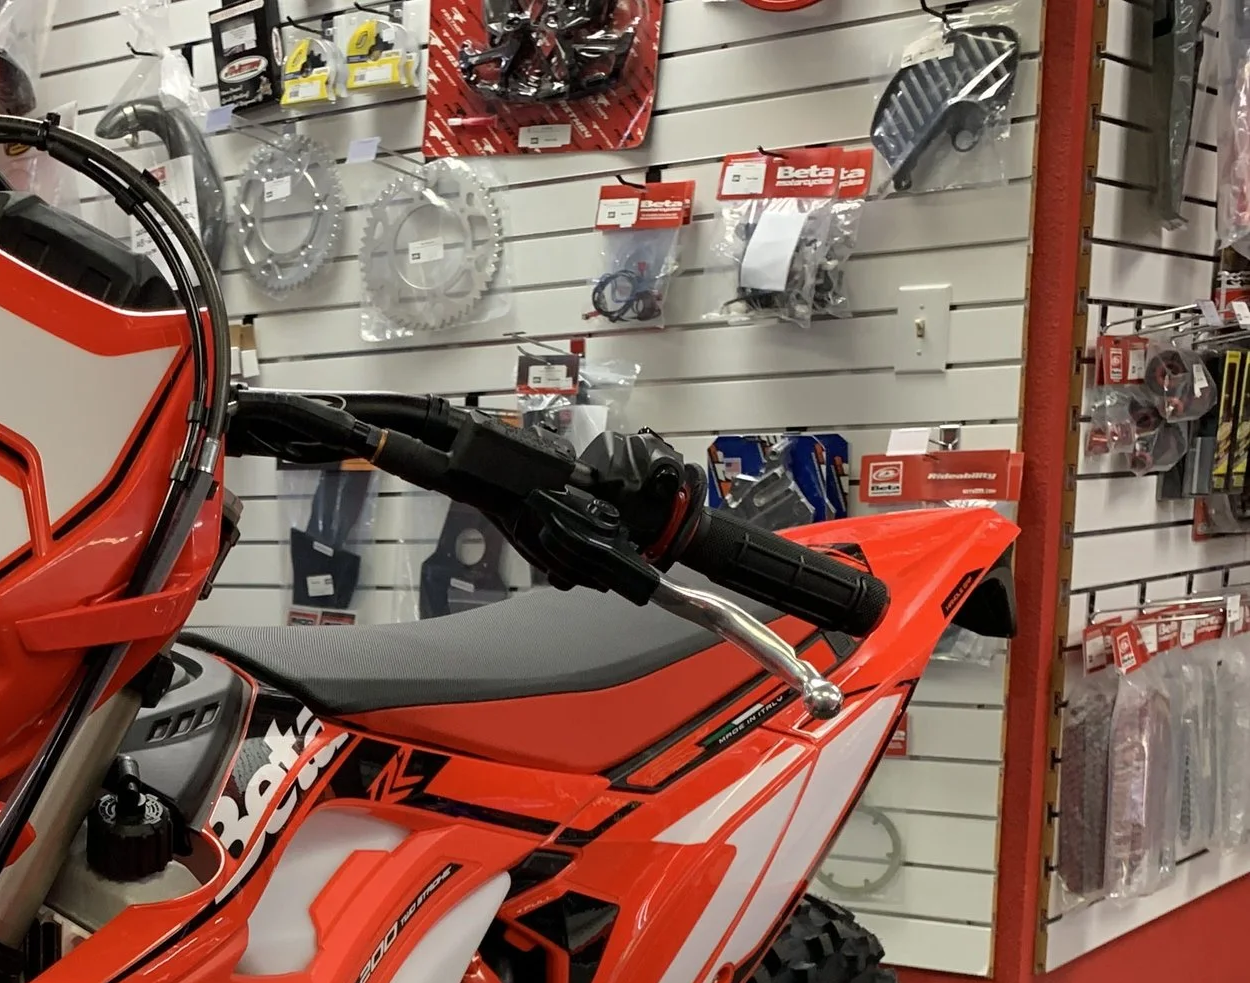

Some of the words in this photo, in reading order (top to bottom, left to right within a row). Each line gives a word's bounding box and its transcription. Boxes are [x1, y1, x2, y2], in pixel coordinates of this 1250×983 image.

[777, 164, 836, 180] Beta
[840, 167, 866, 180] ta
[640, 199, 683, 208] Beta
[927, 472, 997, 480] Rideability
[718, 721, 746, 745] MADE
[746, 715, 757, 725] IN
[758, 695, 784, 718] ITALY
[209, 706, 349, 904] Beta
[400, 902, 417, 926] TWO
[416, 865, 452, 908] STROKE
